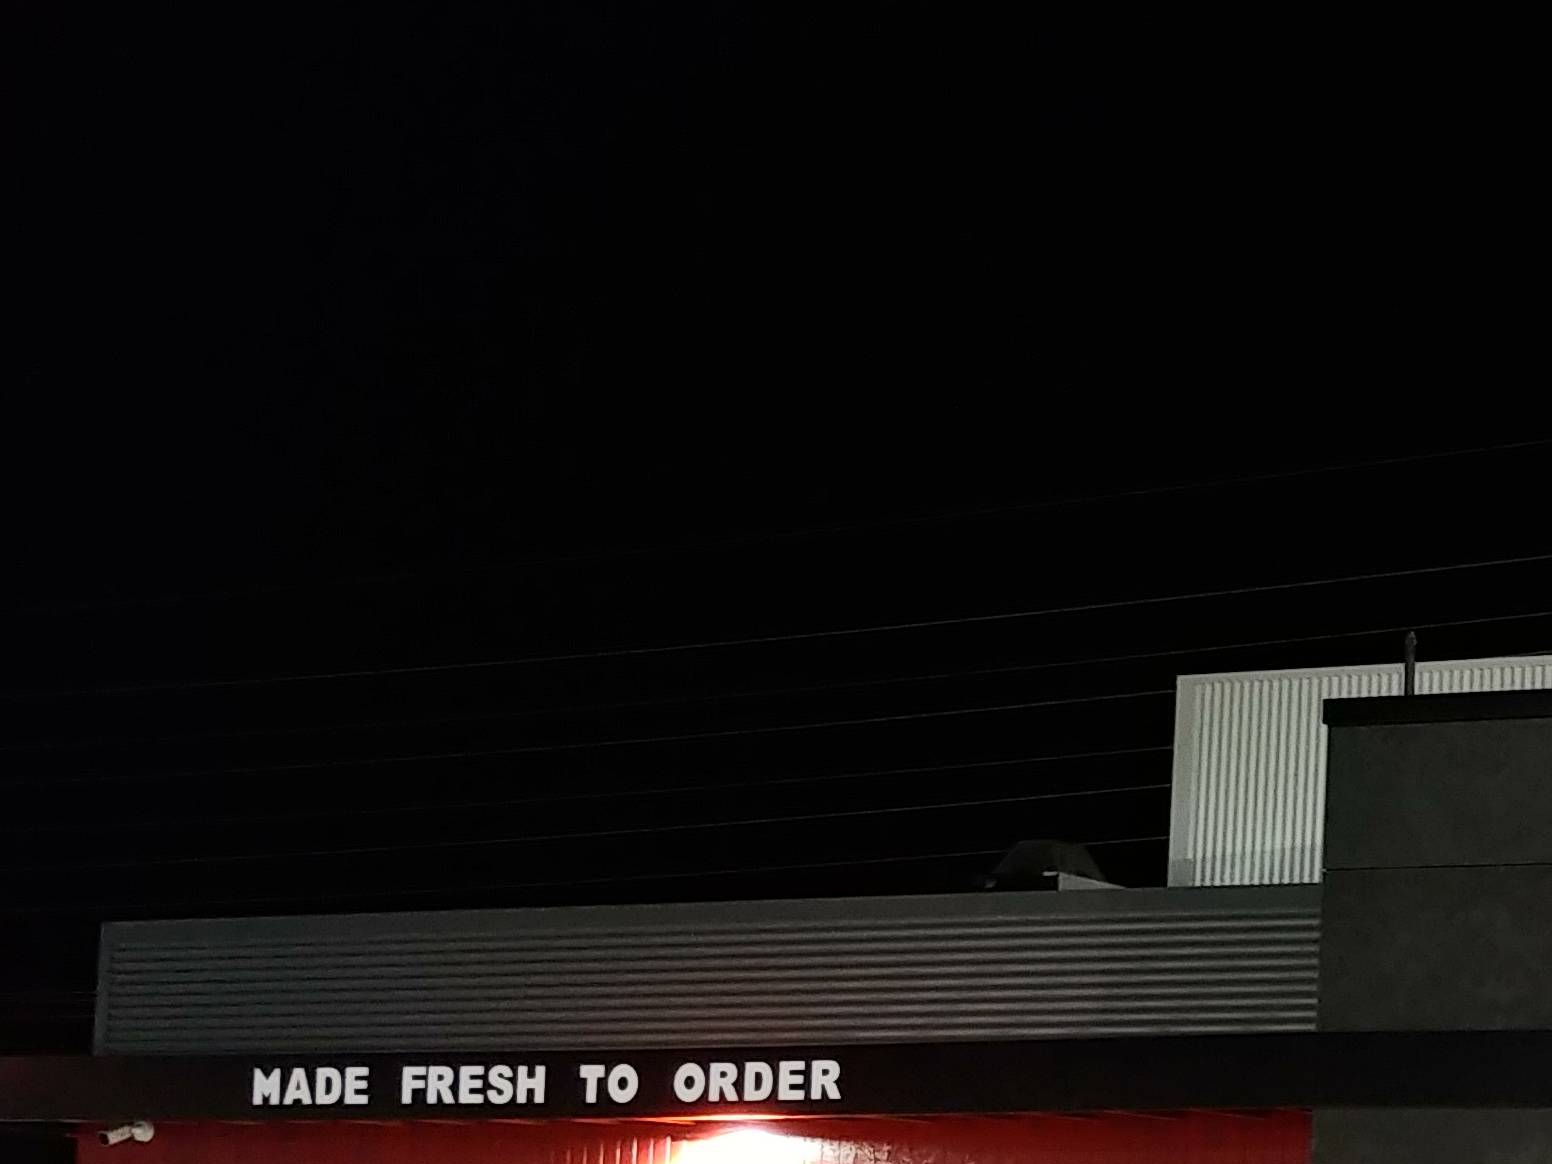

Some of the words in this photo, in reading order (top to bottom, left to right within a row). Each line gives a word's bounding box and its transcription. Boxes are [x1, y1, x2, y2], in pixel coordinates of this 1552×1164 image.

[252, 1066, 370, 1106] MADE
[401, 1064, 546, 1104] FRESH
[579, 1063, 639, 1104] TO
[673, 1059, 842, 1102] ORDER
